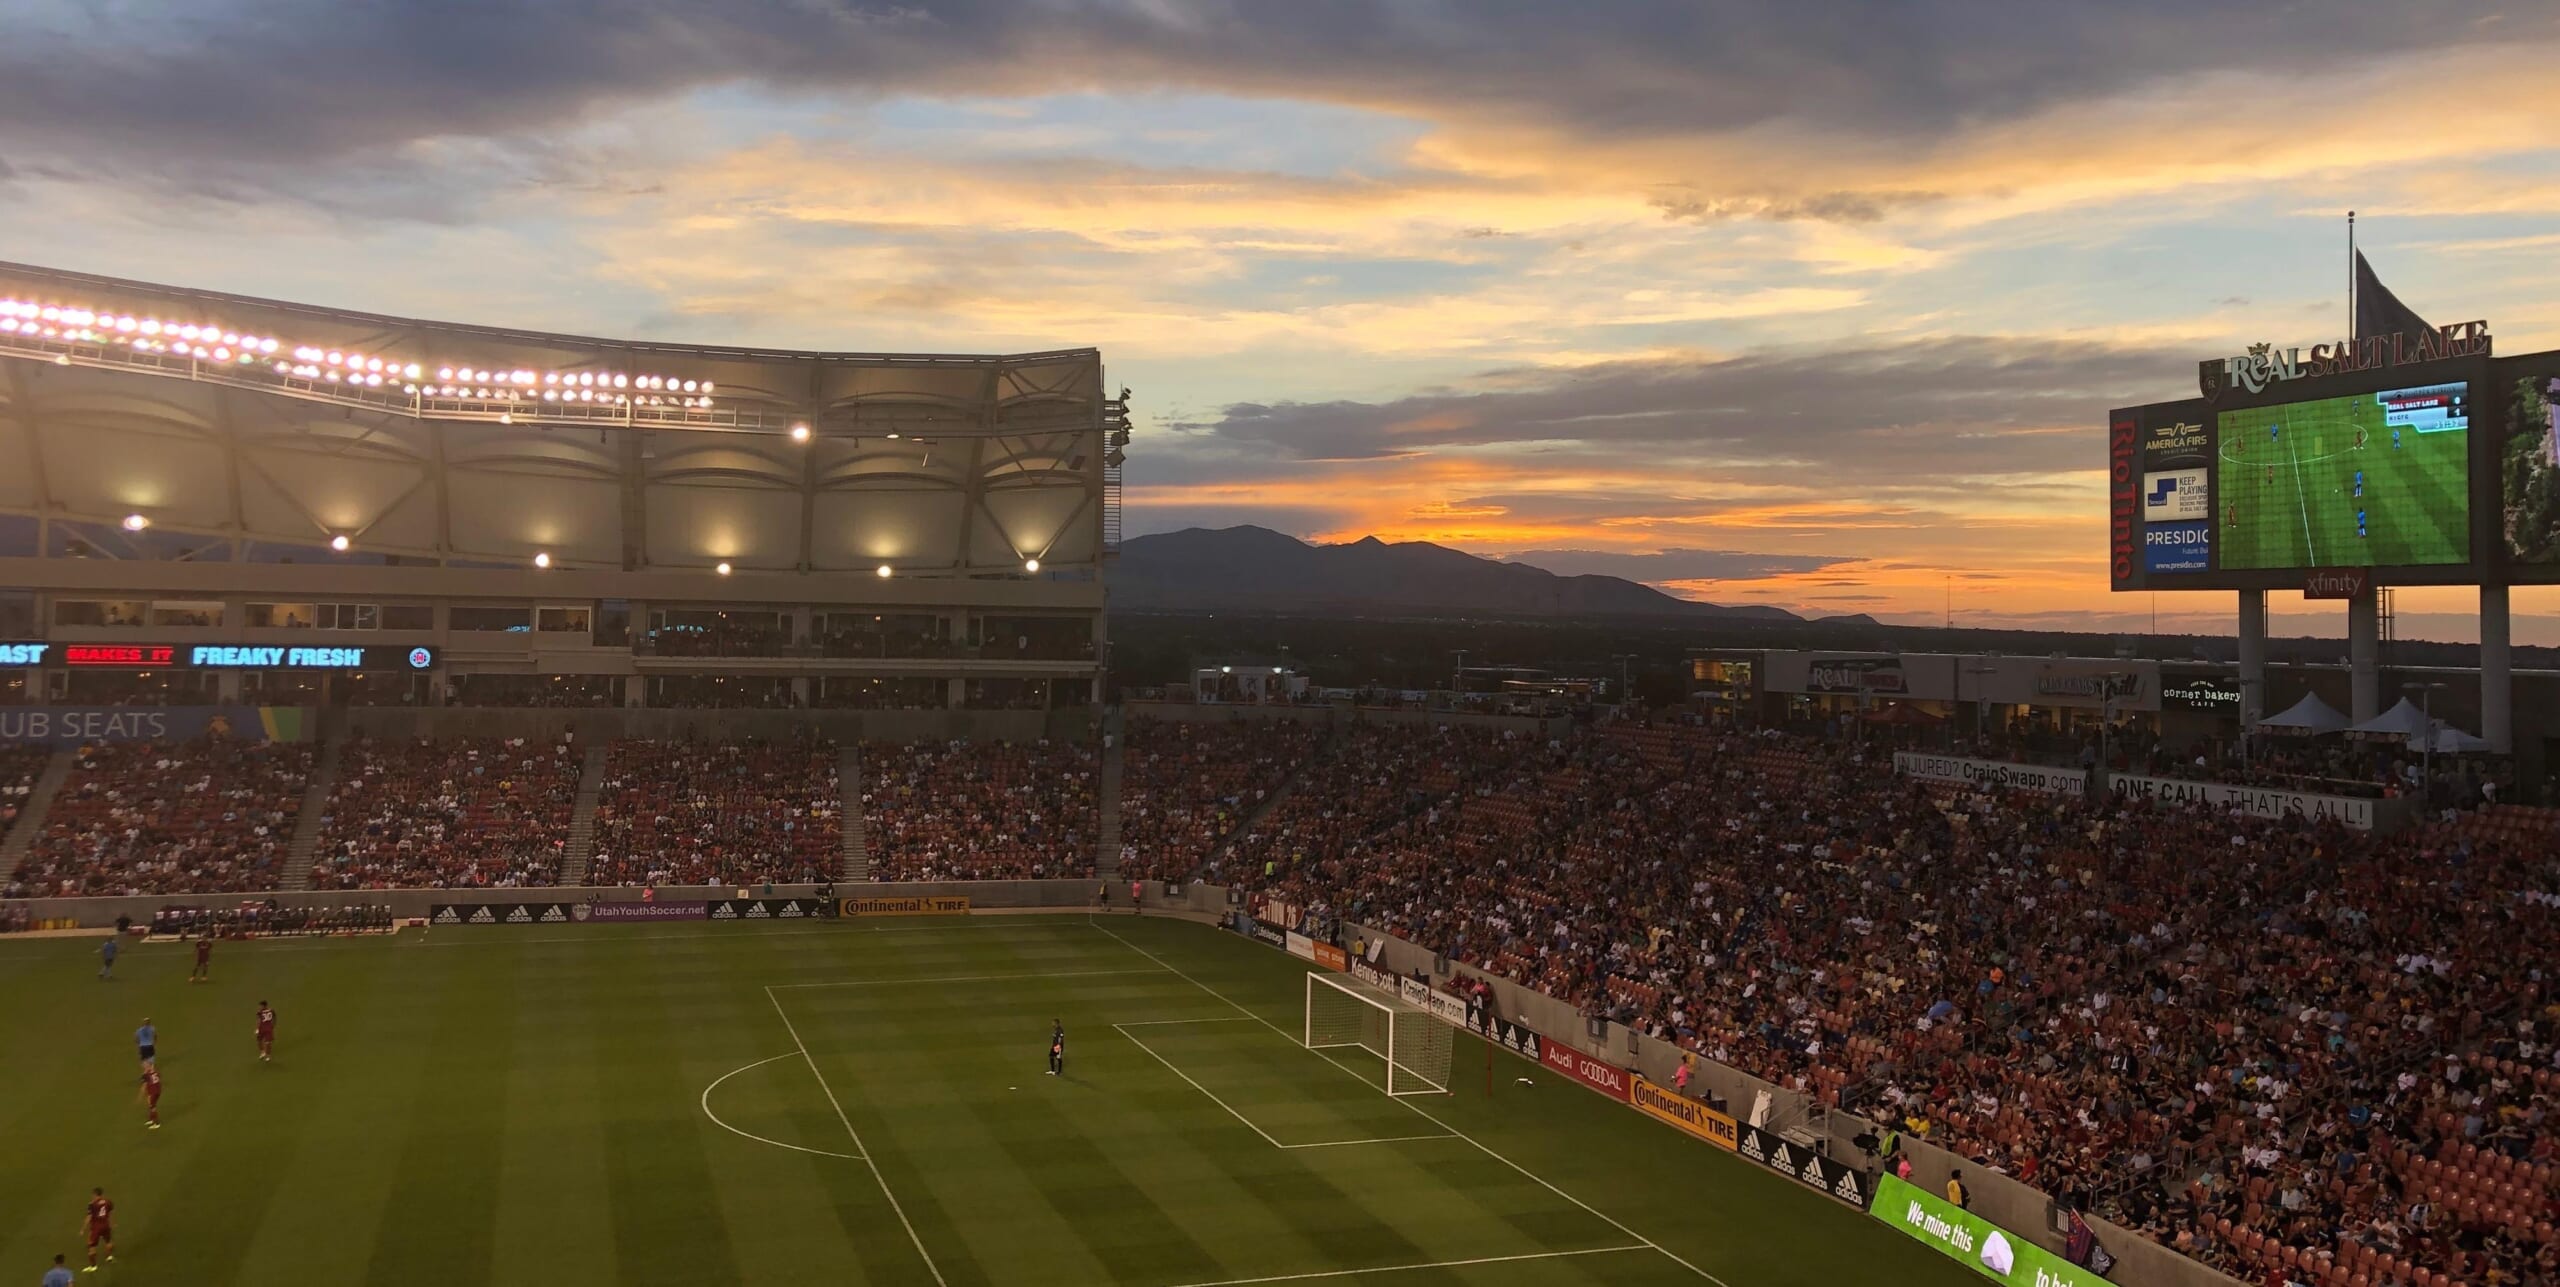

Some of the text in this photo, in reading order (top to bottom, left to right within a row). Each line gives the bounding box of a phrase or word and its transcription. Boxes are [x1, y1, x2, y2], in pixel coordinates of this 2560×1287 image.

[2308, 336, 2390, 378] SALT
[2392, 319, 2490, 366] LAKE
[2145, 435, 2207, 451] AMERICA FIRS
[2179, 476, 2197, 486] KEEP
[2179, 485, 2208, 496] PLAYING
[2307, 572, 2362, 596] xfinity
[0, 644, 49, 664] AST
[192, 647, 361, 667] FREAKY FRESH
[2163, 689, 2240, 702] corner bakery
[0, 712, 167, 738] UB SEATS
[1897, 756, 2082, 792] INJURED? CraigSwapp.com
[2115, 778, 2154, 798] ONE
[594, 906, 706, 917] UtahYouthSoccer.net
[845, 899, 920, 915] Continental
[936, 900, 965, 911] TIRE
[434, 916, 461, 924] adidas
[1549, 1047, 1573, 1069] Audi
[1634, 1080, 1734, 1141] Continental TIRE
[1741, 1144, 1863, 1206] adidas adidas adidas adidas
[1906, 1200, 1974, 1253] We mine this
[2035, 1266, 2049, 1287] to
